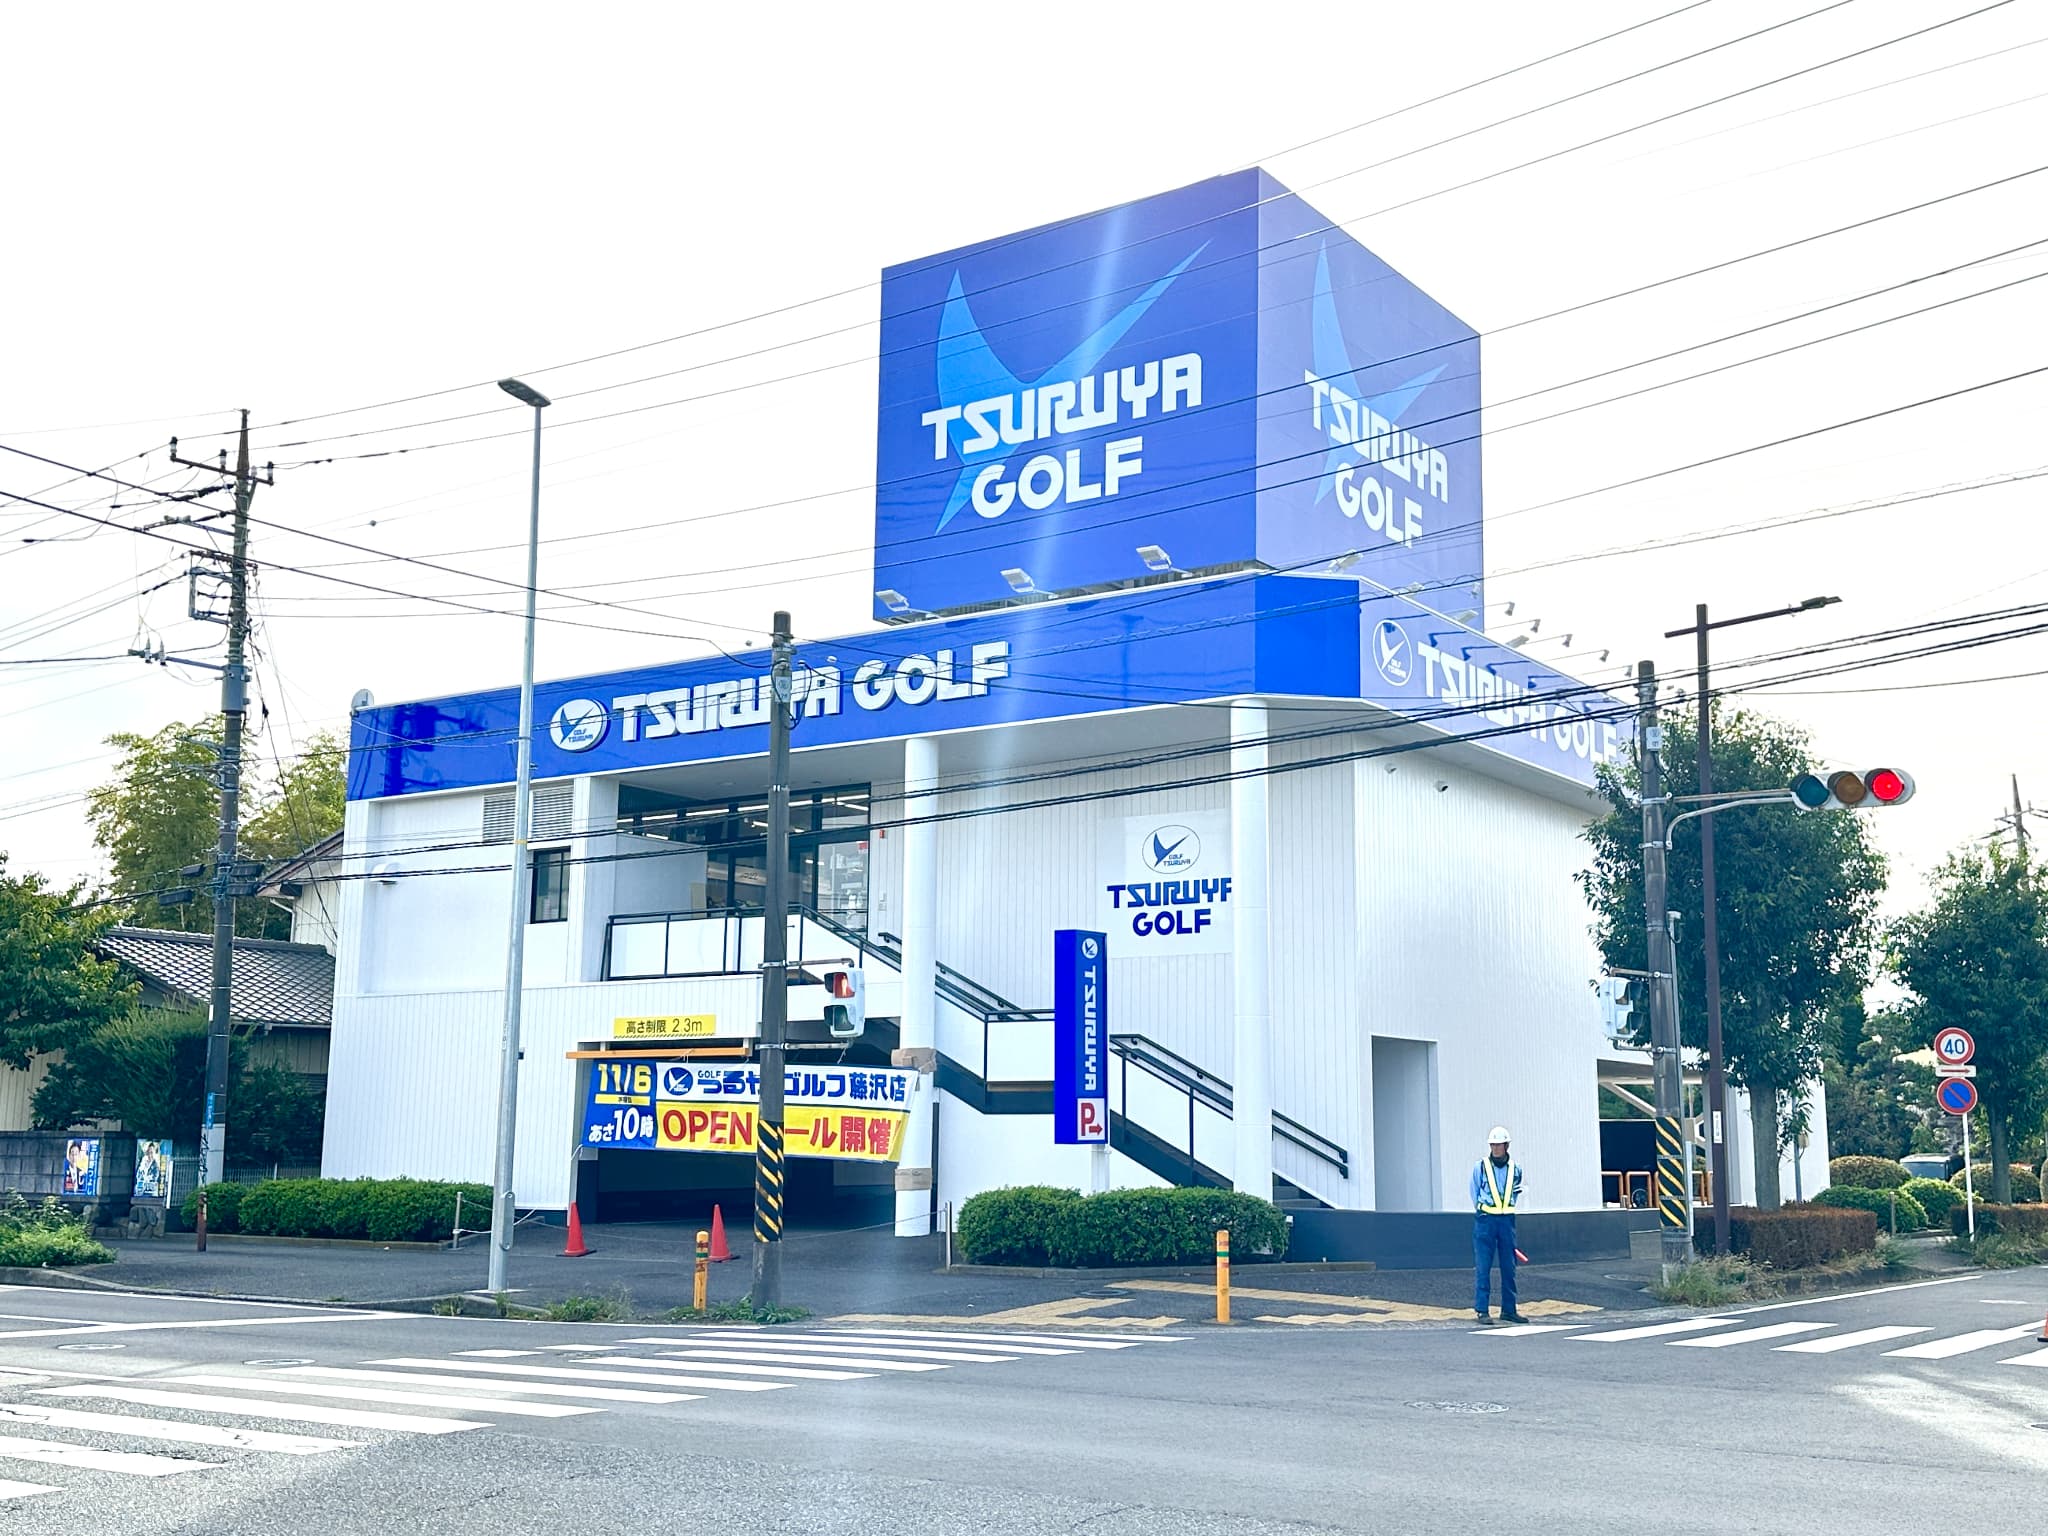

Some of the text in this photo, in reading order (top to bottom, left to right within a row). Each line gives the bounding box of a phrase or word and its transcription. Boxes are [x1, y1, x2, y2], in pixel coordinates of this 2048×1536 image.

[922, 353, 1202, 461] TSURUYA
[1304, 368, 1449, 504] TSURUYA
[971, 435, 1144, 519] GOLF
[1335, 462, 1423, 549] GOLF
[853, 640, 1011, 711] GOLF
[1417, 641, 1618, 763] TSURUYA GOLF
[1132, 908, 1211, 937] GOLF
[626, 1019, 667, 1035] 高さ制限
[1084, 965, 1097, 1092] TSURUYA
[1944, 1038, 1966, 1055] 40
[598, 1063, 652, 1094] 11/6
[698, 1070, 721, 1079] GOLF
[662, 1109, 753, 1146] OPEN
[1080, 1102, 1096, 1137] P
